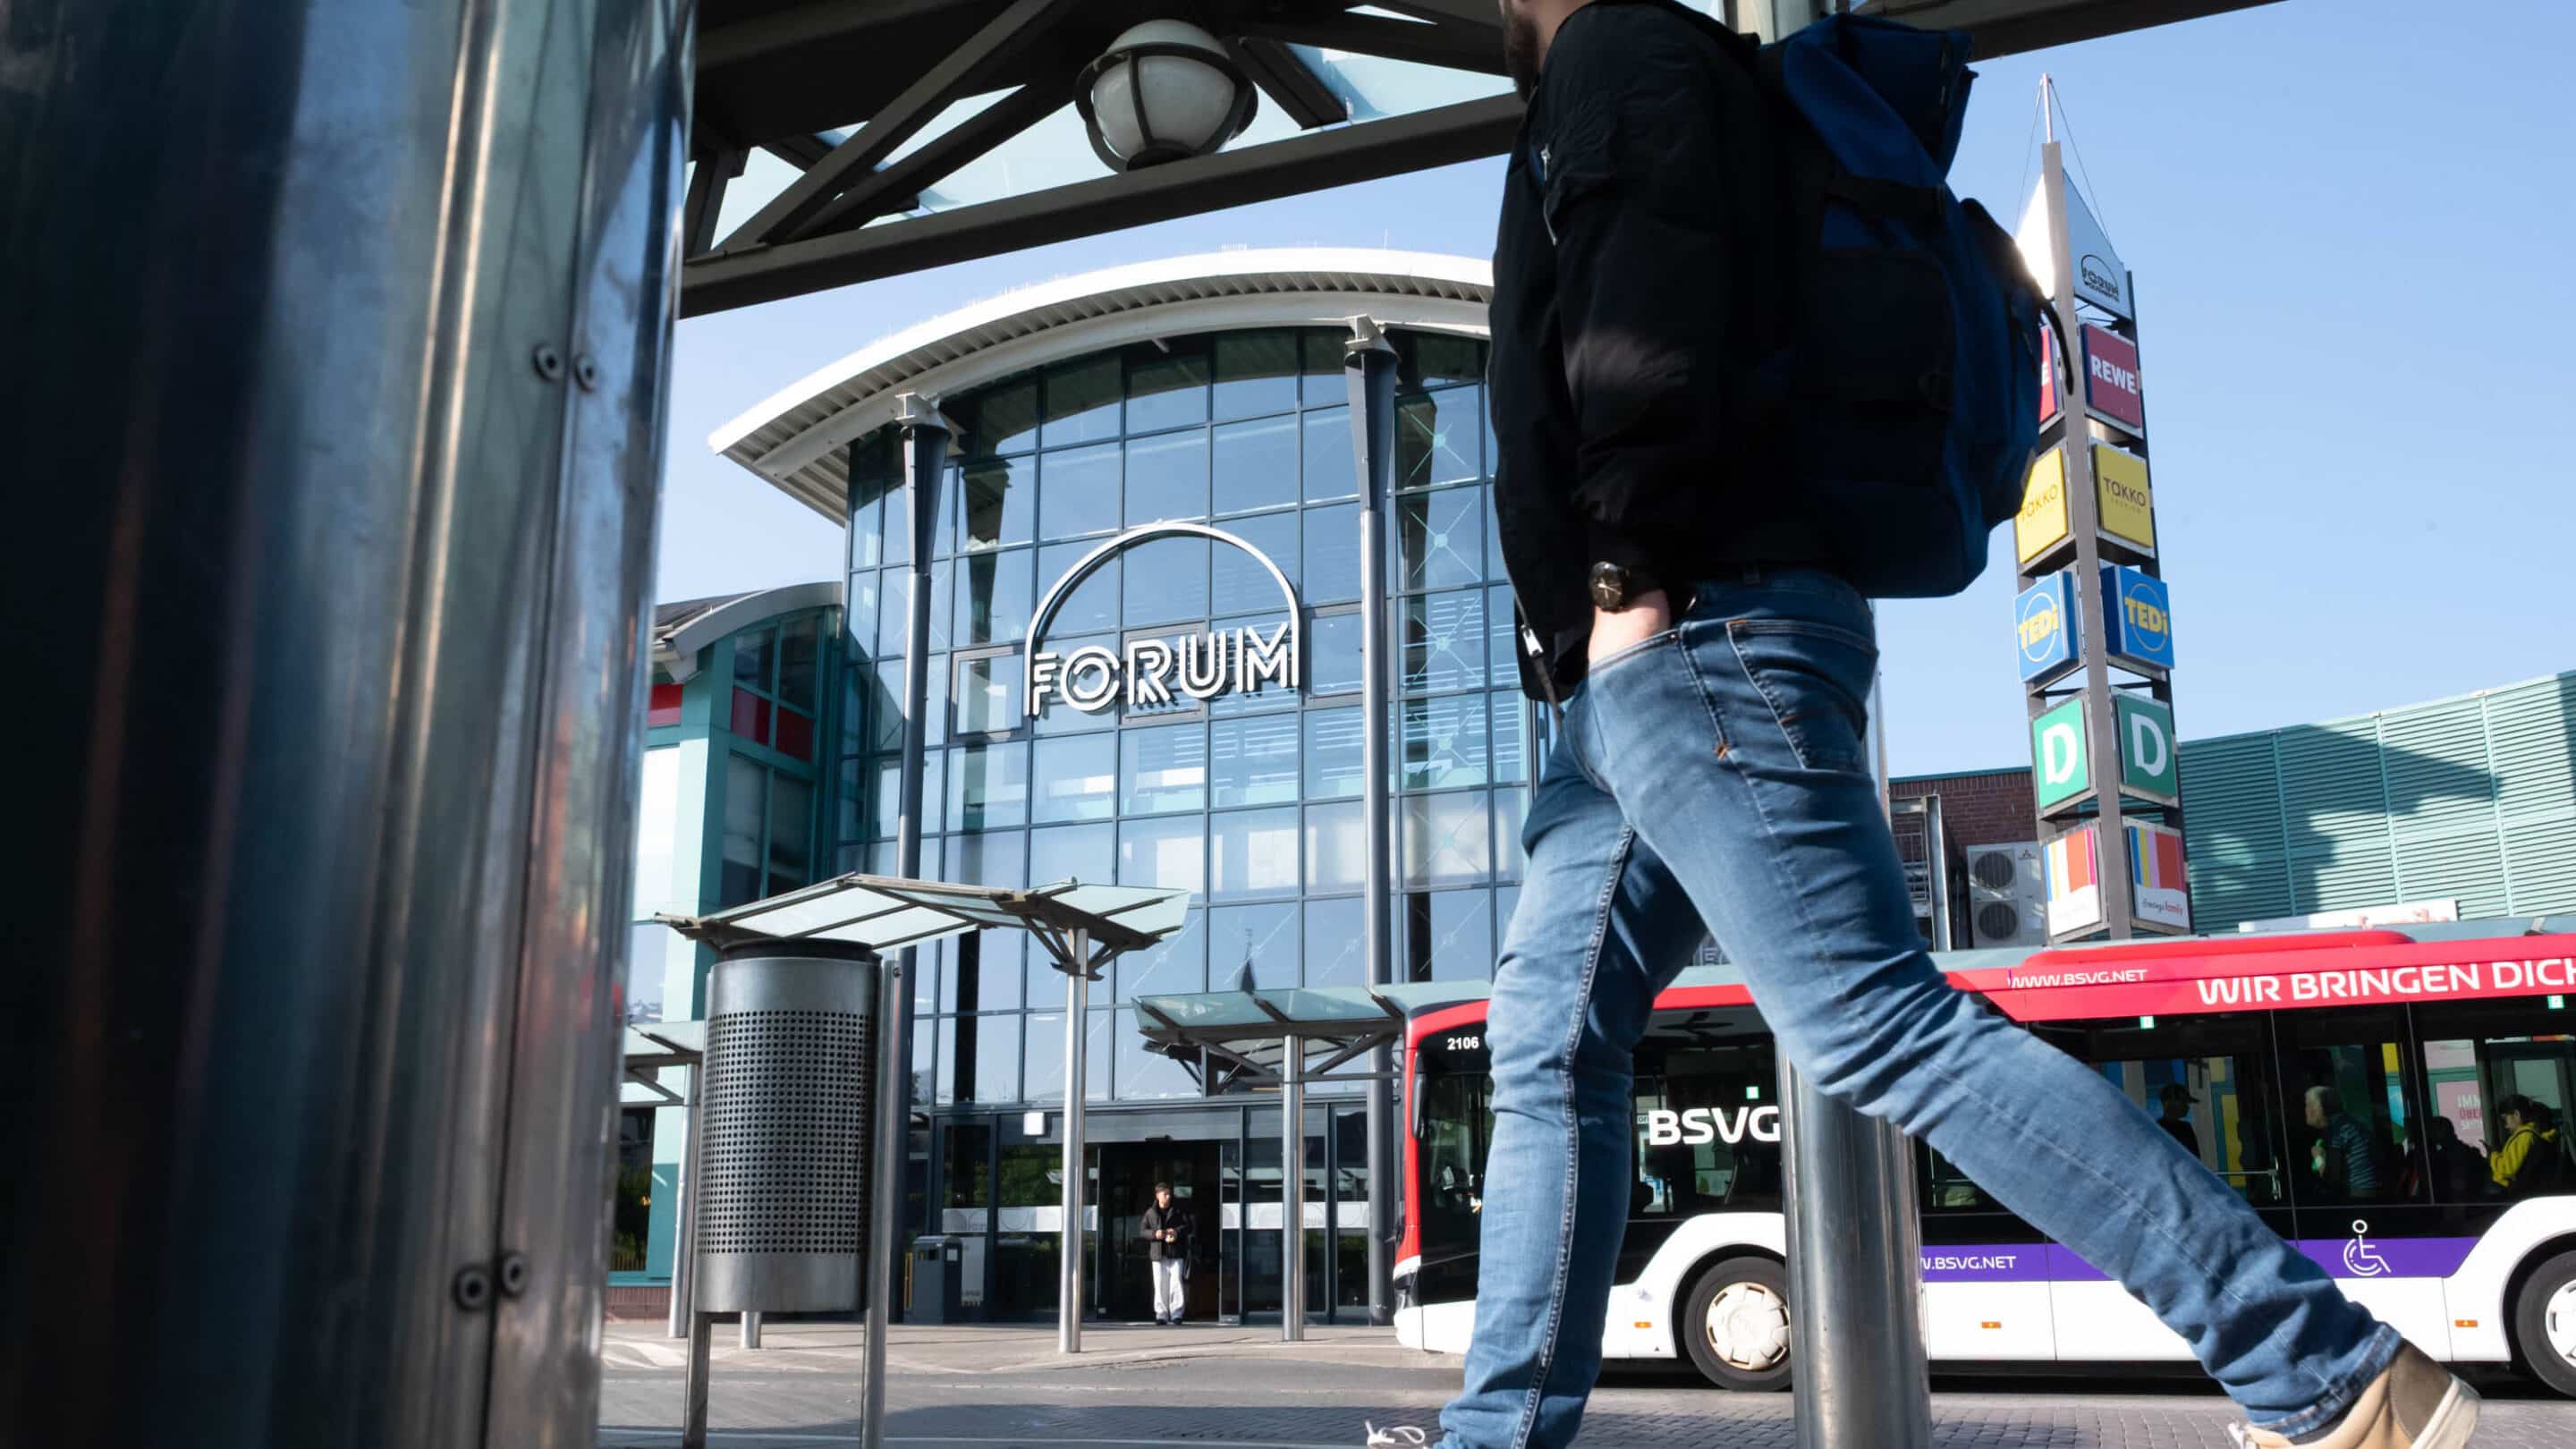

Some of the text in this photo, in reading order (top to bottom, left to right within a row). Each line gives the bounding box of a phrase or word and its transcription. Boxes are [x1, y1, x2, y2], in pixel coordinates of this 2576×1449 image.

[2090, 354, 2137, 394] REWE
[1024, 622, 1300, 716] FORUM
[2043, 723, 2078, 785] D
[2131, 713, 2167, 777] D
[2007, 970, 2148, 988] WWW.BSVG.NET
[2197, 974, 2282, 1005] WIR
[2291, 963, 2481, 1000] BRINGEN
[1447, 1037, 1479, 1050] 2106
[1648, 1106, 1782, 1146] BSVG
